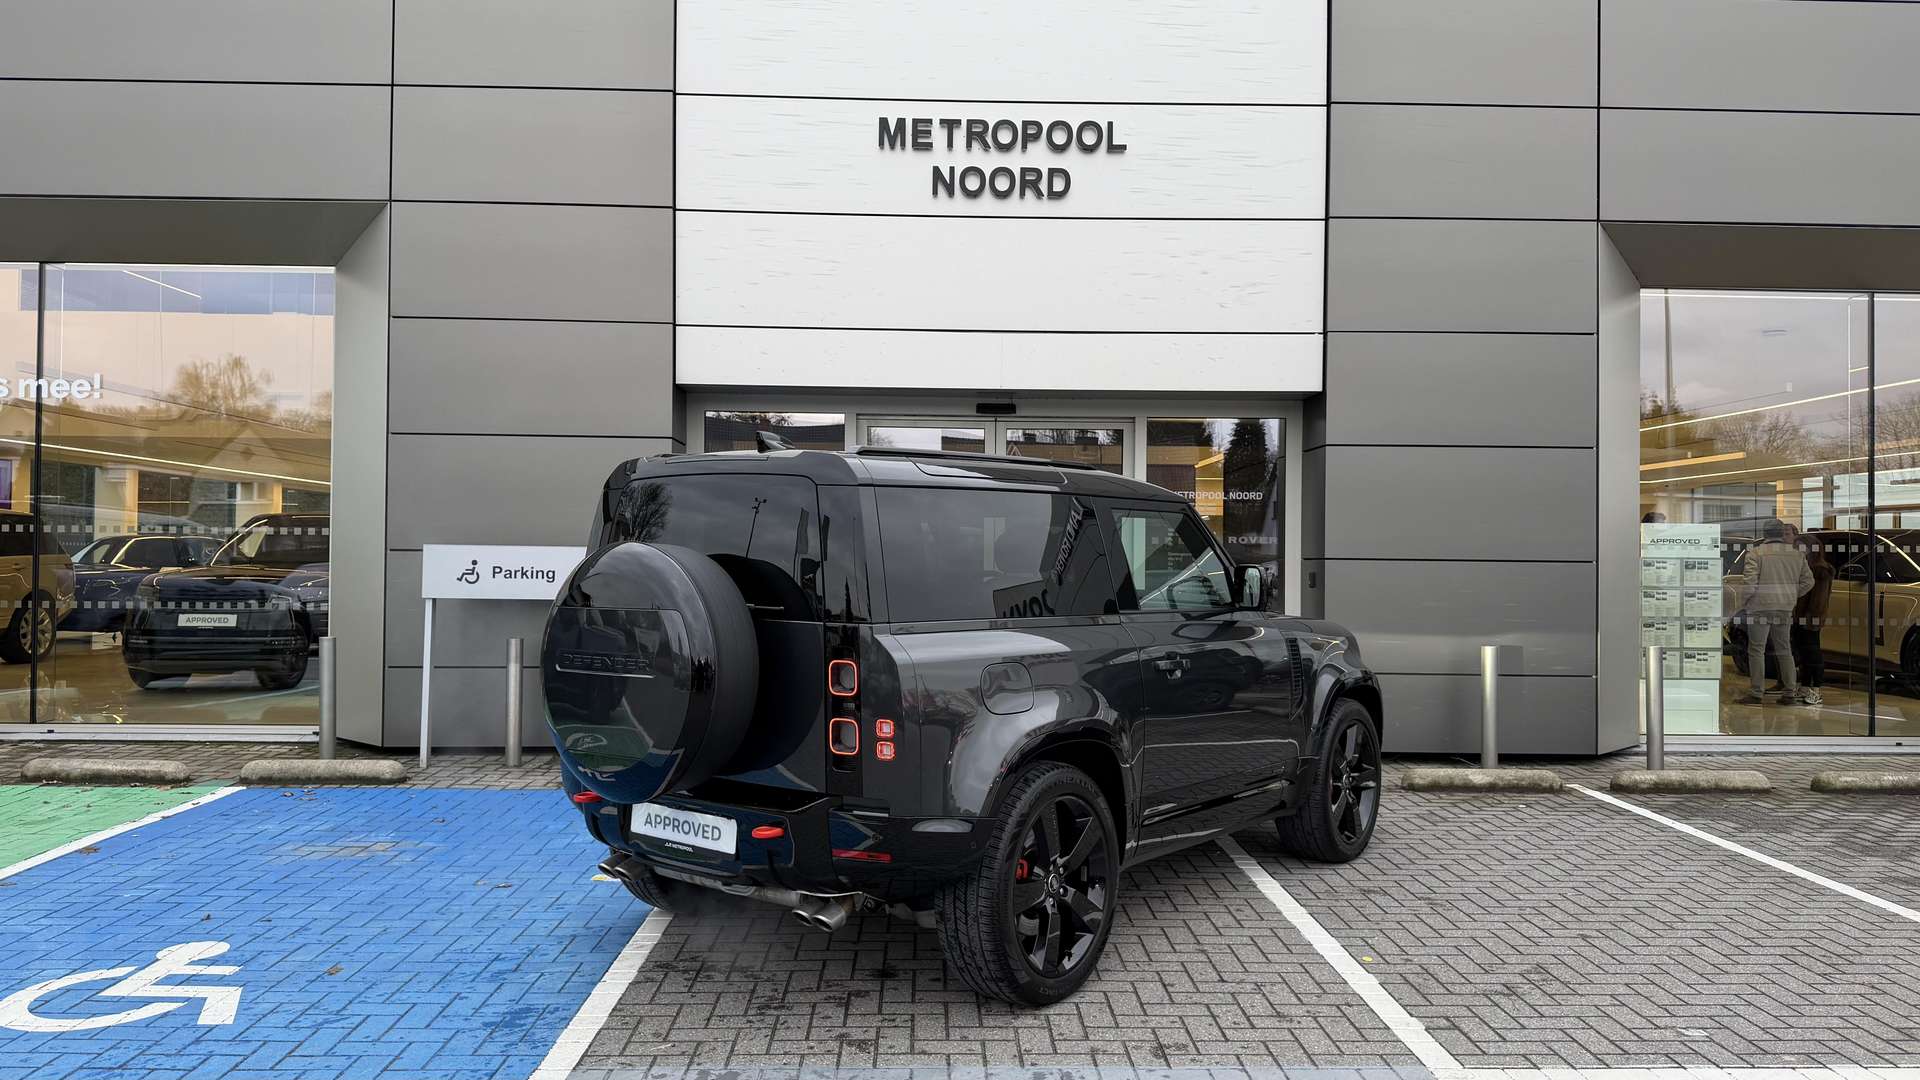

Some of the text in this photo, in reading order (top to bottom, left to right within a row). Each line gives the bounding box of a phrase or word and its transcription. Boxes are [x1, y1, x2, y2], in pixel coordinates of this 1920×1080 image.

[878, 116, 1128, 152] METROPOOL
[931, 165, 1072, 199] NOORD
[18, 373, 102, 399] mee!
[1229, 490, 1263, 500] NOORD
[1228, 536, 1278, 544] ROVER
[492, 565, 556, 583] Parking
[185, 616, 229, 624] APPROVED
[644, 812, 722, 841] APPROVED
